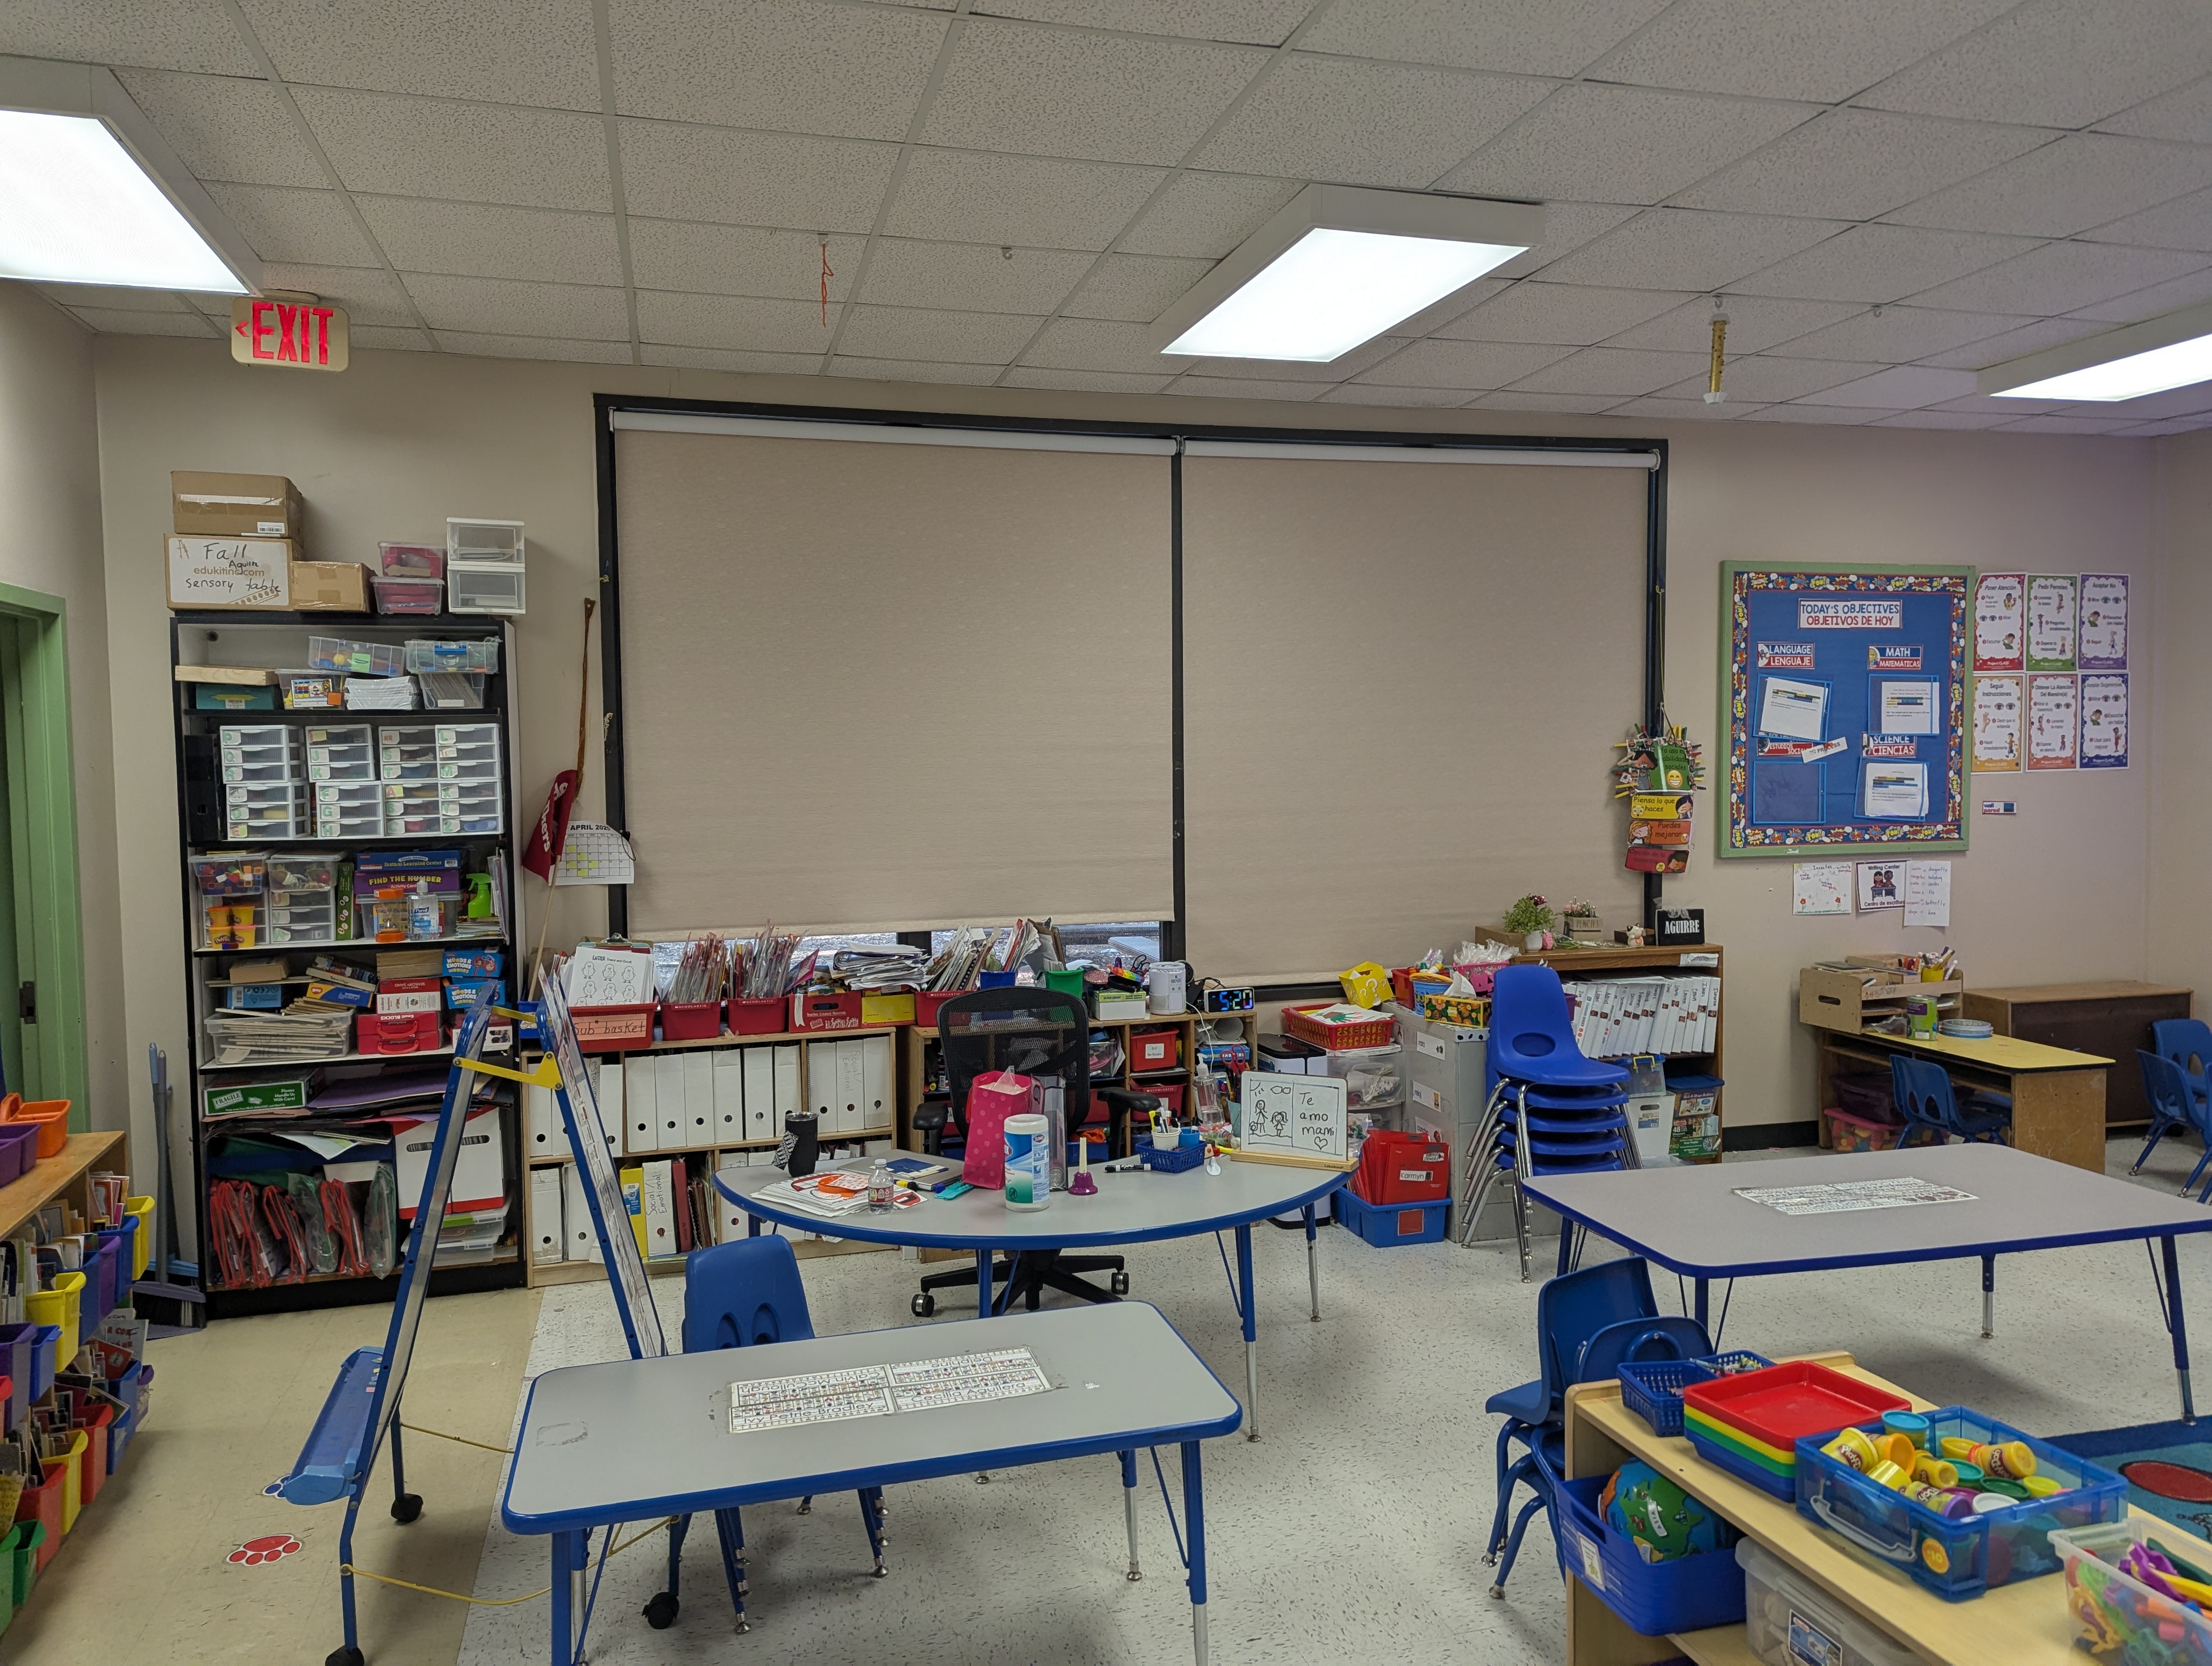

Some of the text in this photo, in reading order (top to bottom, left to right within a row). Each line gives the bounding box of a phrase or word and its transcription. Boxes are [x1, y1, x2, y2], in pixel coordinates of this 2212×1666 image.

[252, 301, 333, 365] EXIT
[204, 543, 247, 559] Fall
[1812, 578, 1827, 587] POW!
[1801, 603, 1899, 614] TODAY'S OBJECTIVES
[1806, 616, 1894, 626] OBJETIVOS DE HOY
[1769, 645, 1811, 654] LANGUAGE
[1886, 647, 1911, 657] MATH
[1771, 657, 1810, 666] LENGUAJE
[223, 732, 232, 744] P
[440, 731, 448, 741] L
[1874, 735, 1909, 744] SCIENCE
[312, 750, 319, 761] J
[384, 749, 391, 760] S
[1873, 745, 1914, 755] CIENCIAS
[225, 751, 235, 762] Q
[226, 768, 234, 780] R
[313, 767, 323, 778] K
[384, 767, 393, 777] T
[442, 766, 453, 776] M
[387, 786, 395, 797] A
[443, 788, 451, 797] X
[322, 806, 332, 817] G
[387, 802, 395, 813] B
[442, 803, 449, 813] Y
[322, 825, 332, 835] H
[388, 820, 398, 831] C
[1655, 831, 1682, 839] mejorar
[1806, 831, 1822, 841] POW!
[369, 877, 388, 886] FIND
[1664, 919, 1700, 935] AGUIRRE
[1220, 990, 1253, 1011] 5:20
[842, 1057, 853, 1092] Emotional
[215, 1092, 240, 1105] FRAGILE
[1300, 1091, 1314, 1105] Te
[1300, 1112, 1328, 1122] amo
[1302, 1125, 1335, 1137] mami
[1400, 1171, 1424, 1180] Karmyn
[659, 1173, 667, 1214] Emotional
[741, 1372, 880, 1393] Calvin McCullough
[911, 1382, 1026, 1402] Cecilia Aguilera
[769, 1402, 873, 1420] Petrie-Bradley
[1651, 1510, 1662, 1530] ASIA
